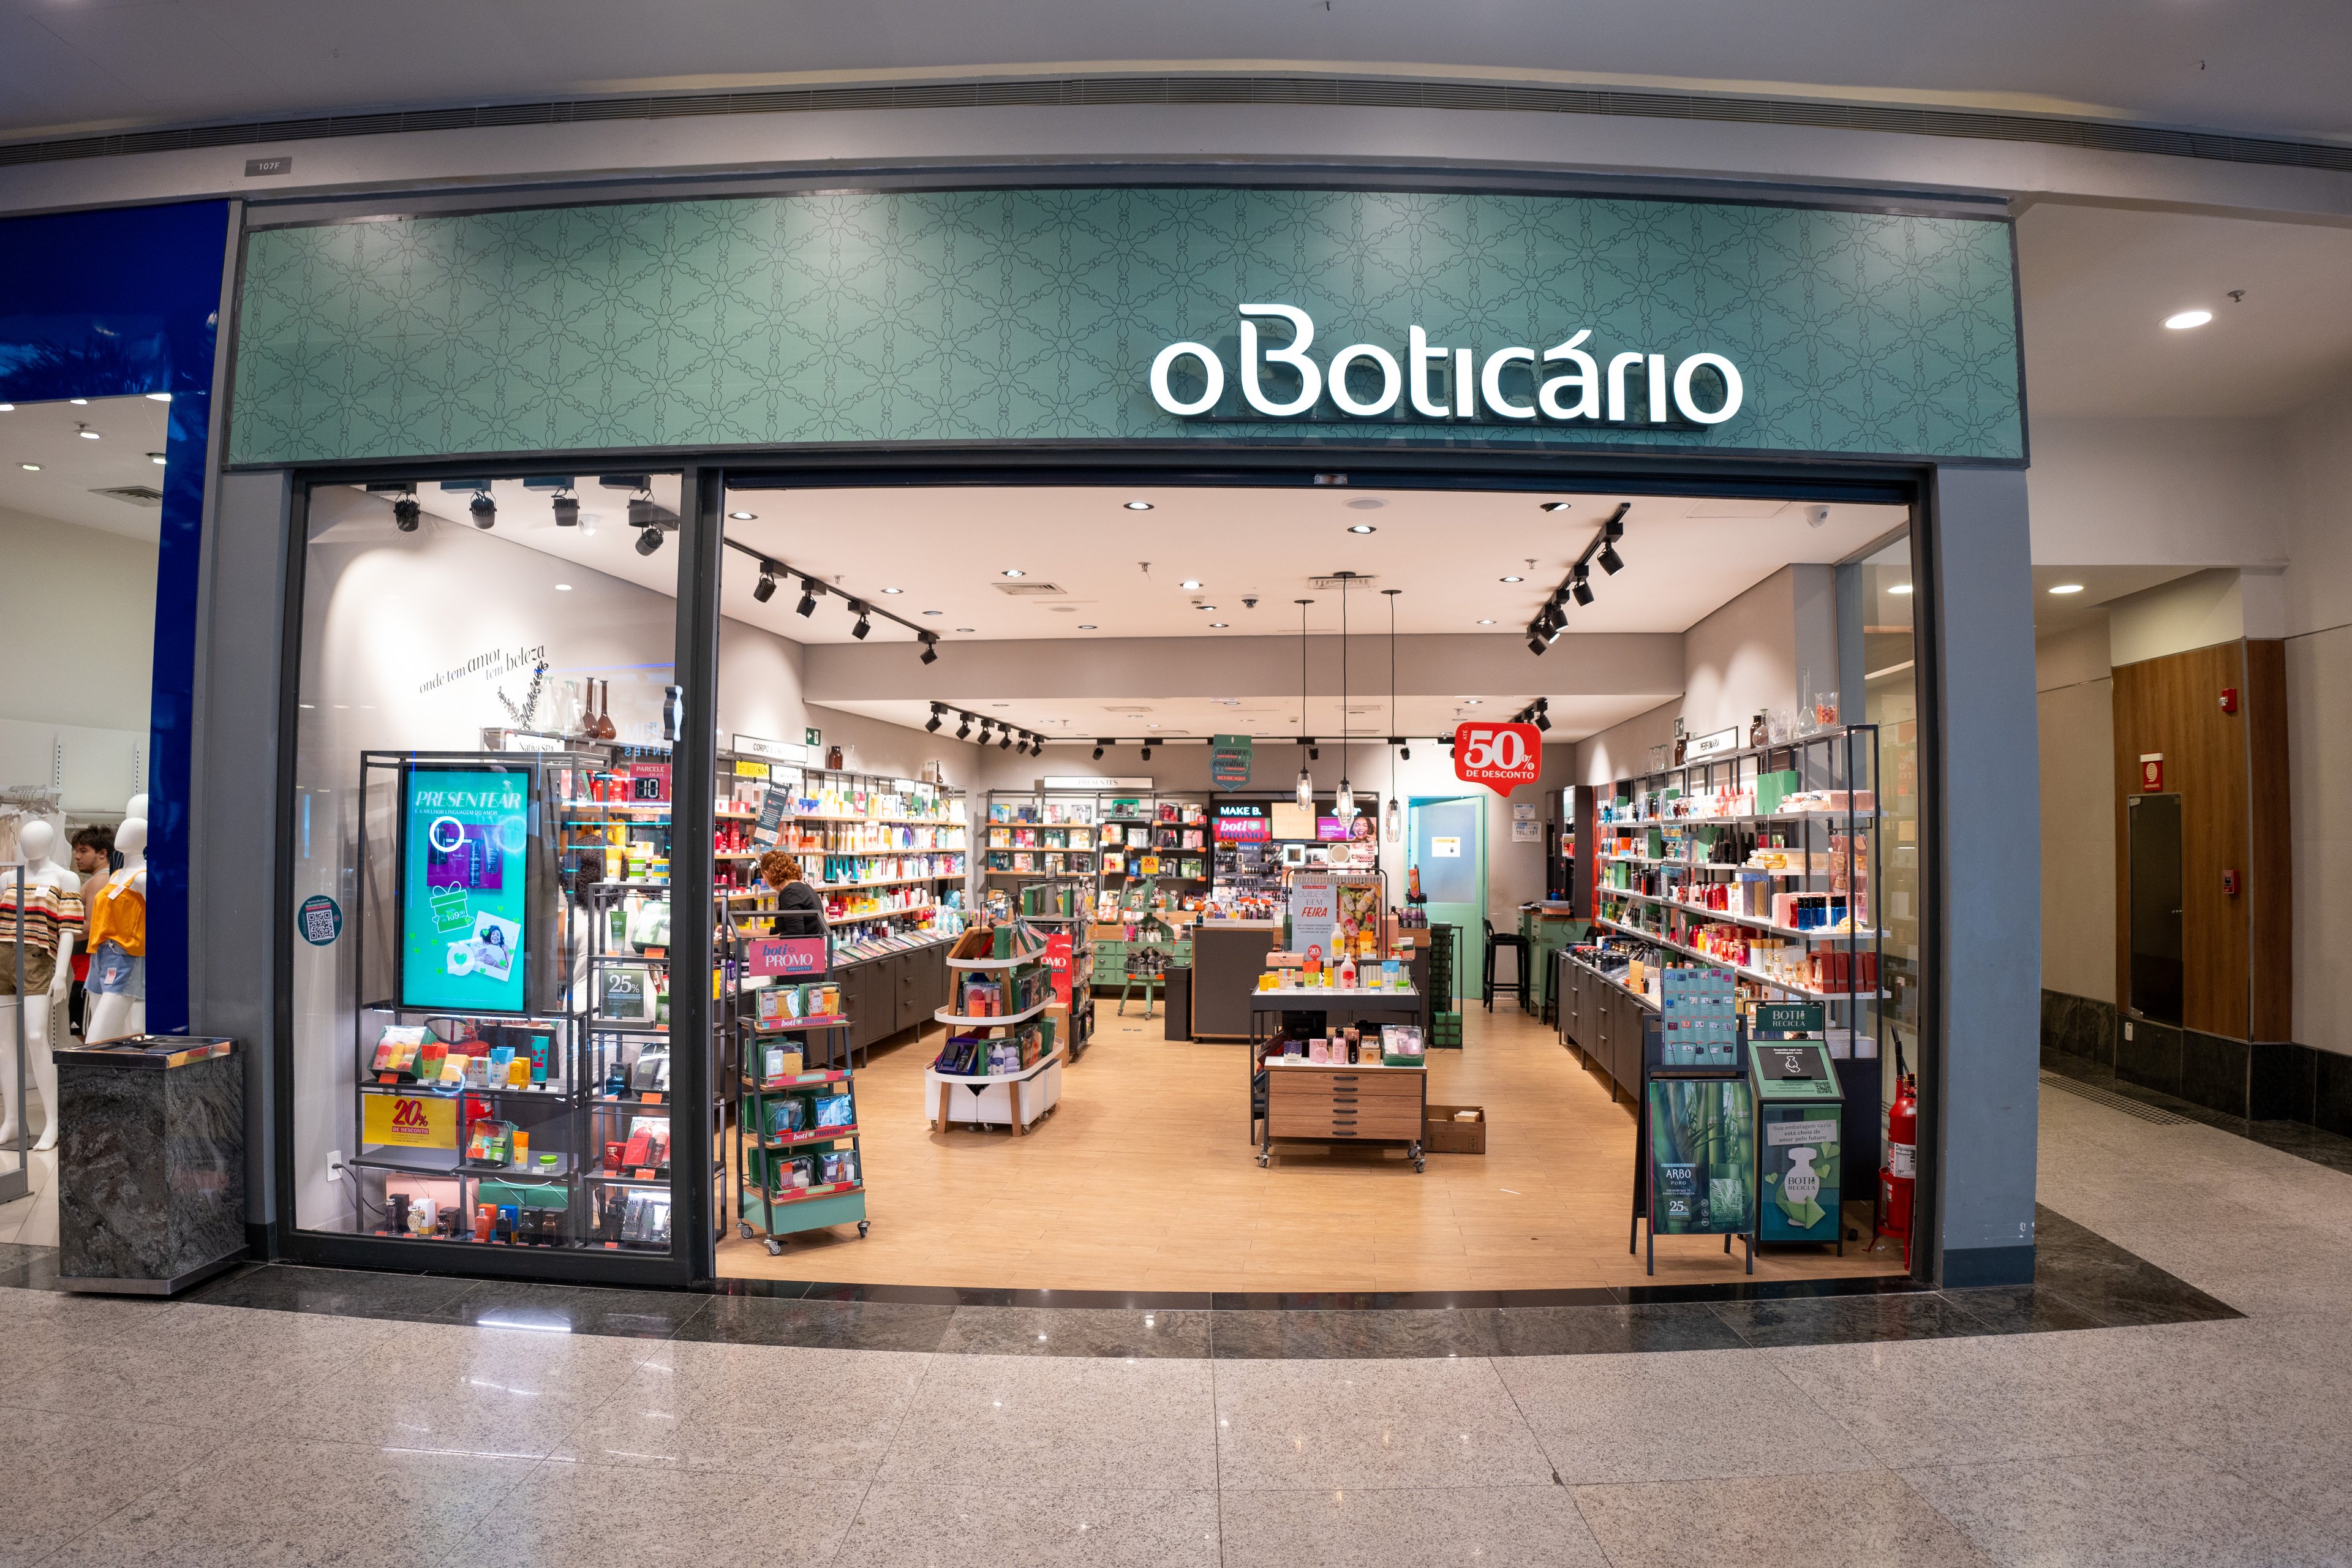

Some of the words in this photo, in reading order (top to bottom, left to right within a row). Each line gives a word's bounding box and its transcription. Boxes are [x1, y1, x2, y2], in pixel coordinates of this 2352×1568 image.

[259, 162, 281, 170] 107F
[1238, 303, 1743, 425] Boticário
[486, 666, 503, 680] tem
[507, 645, 545, 672] beleza
[420, 673, 445, 693] onde
[447, 666, 466, 682] tem
[467, 648, 501, 673] amor
[753, 743, 770, 753] CORPO
[1464, 729, 1535, 771] 50%
[1482, 770, 1534, 779] DESCONTO
[771, 785, 787, 795] botik
[415, 791, 521, 809] PRESENTEAR
[1220, 806, 1250, 815] MAKE
[1252, 807, 1262, 816] B.
[1220, 820, 1248, 831] boti
[1221, 831, 1264, 840] PROMO
[1301, 907, 1328, 918] FEIRA
[763, 944, 788, 956] boti
[766, 953, 813, 967] PROMO
[1041, 957, 1066, 967] OMO
[608, 974, 640, 993] 25%
[1773, 1011, 1799, 1020] BOTI
[782, 1019, 796, 1027] boti
[393, 1099, 429, 1126] 20%
[793, 1132, 808, 1140] boti
[814, 1129, 841, 1137] PROMO
[1666, 1169, 1691, 1180] ARBO
[1669, 1200, 1689, 1212] 25%
